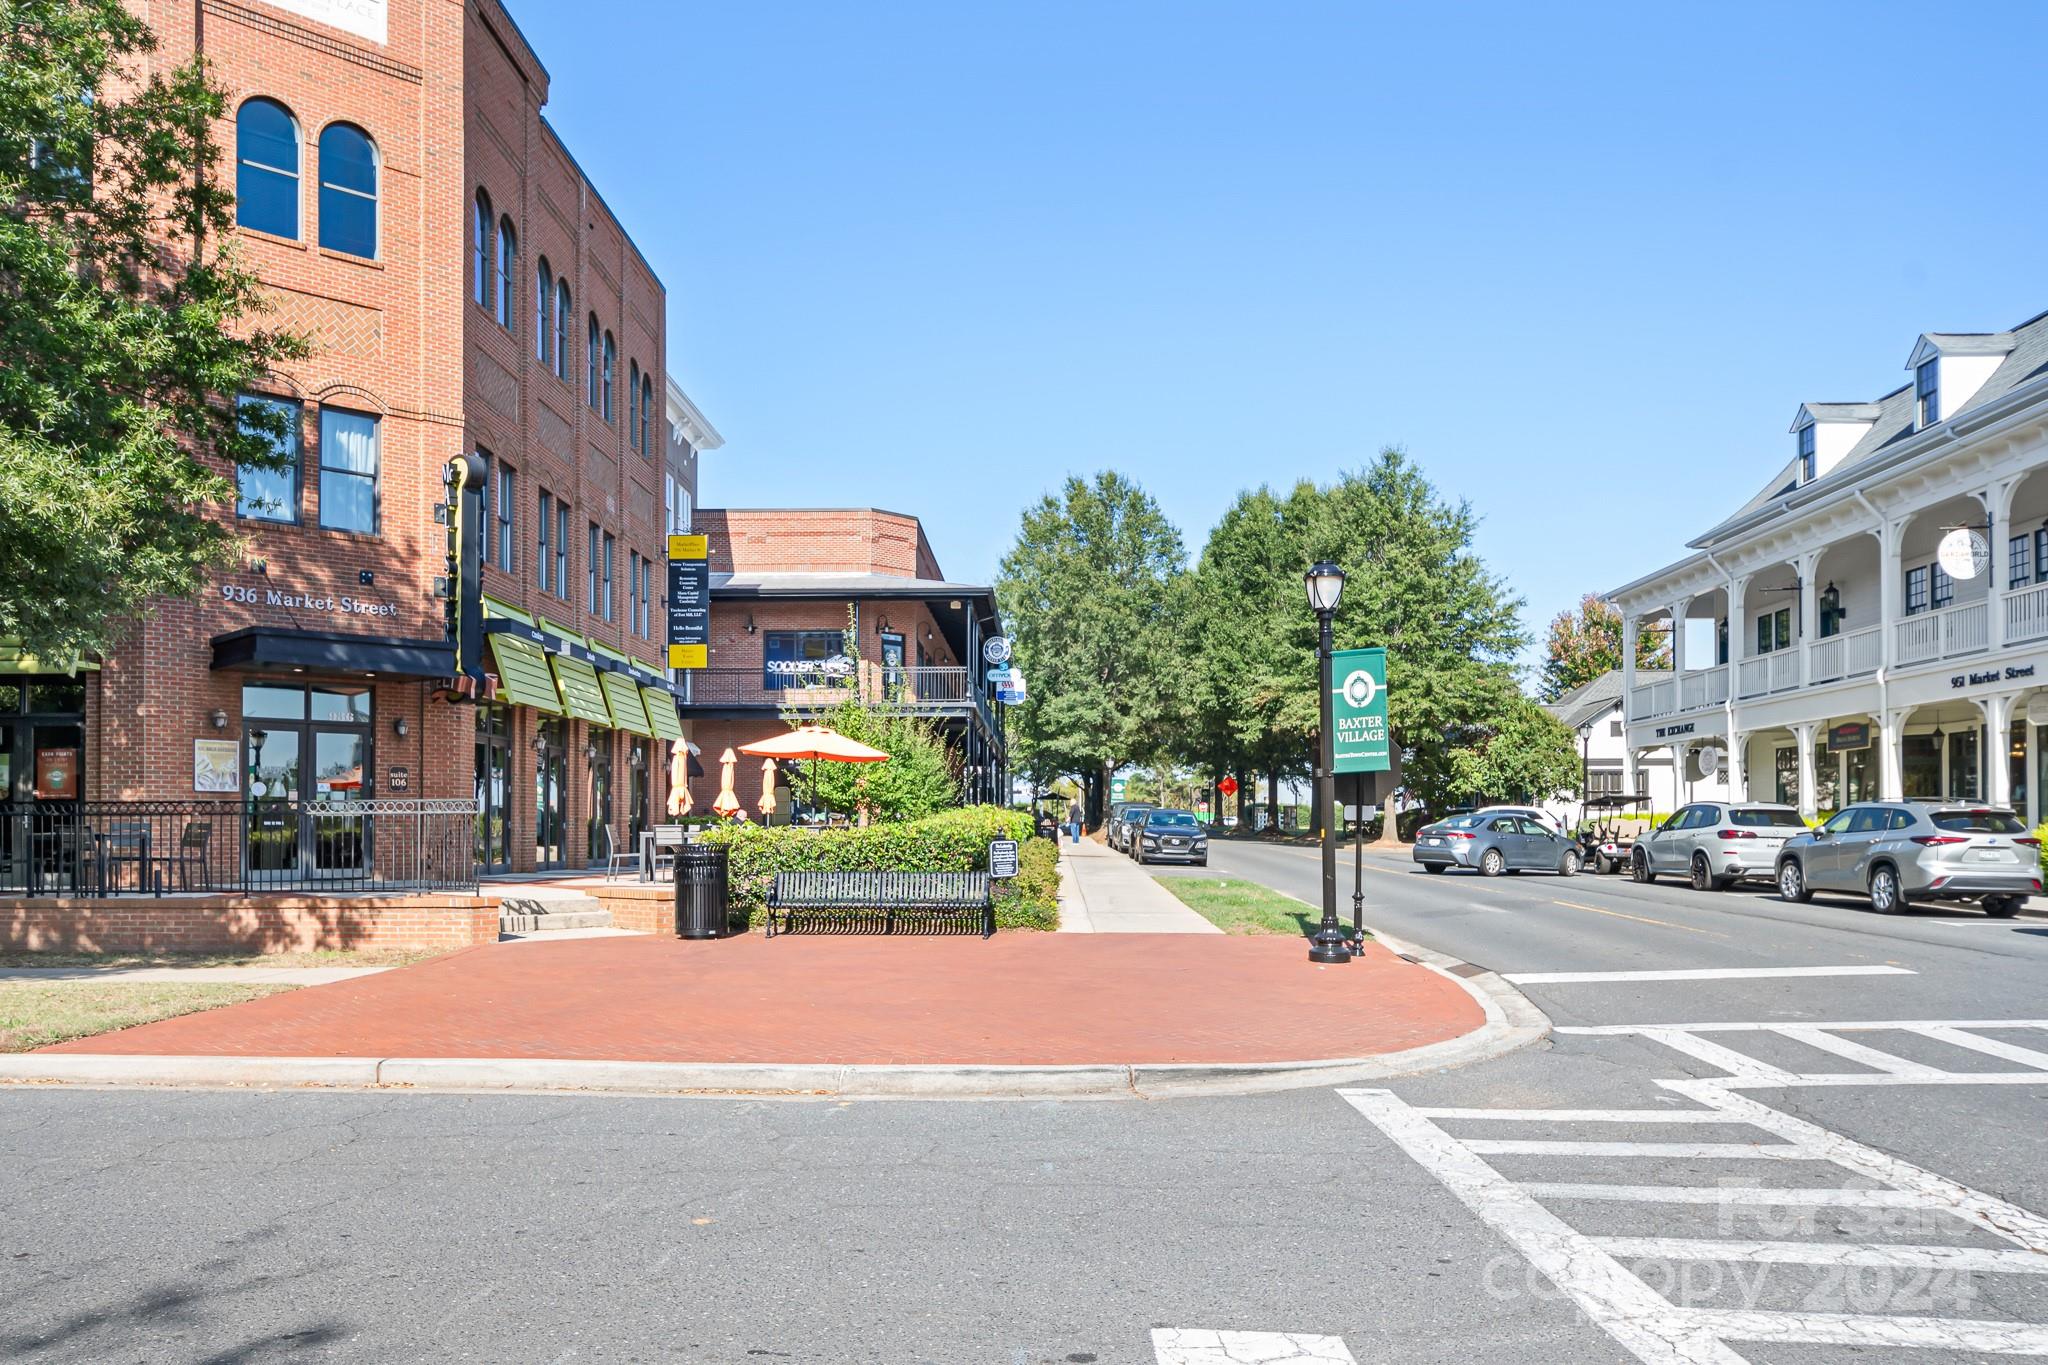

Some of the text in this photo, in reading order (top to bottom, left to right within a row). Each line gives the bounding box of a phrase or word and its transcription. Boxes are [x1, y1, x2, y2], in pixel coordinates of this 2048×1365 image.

[222, 584, 398, 617] 936 Market Street
[1969, 669, 2001, 687] Market
[2004, 664, 2035, 681] Street
[1338, 715, 1383, 730] BAXTER
[1336, 729, 1386, 743] VILLAGE
[1655, 722, 1695, 739] THE EXCHANGE
[390, 771, 408, 779] suite
[390, 778, 407, 787] 106
